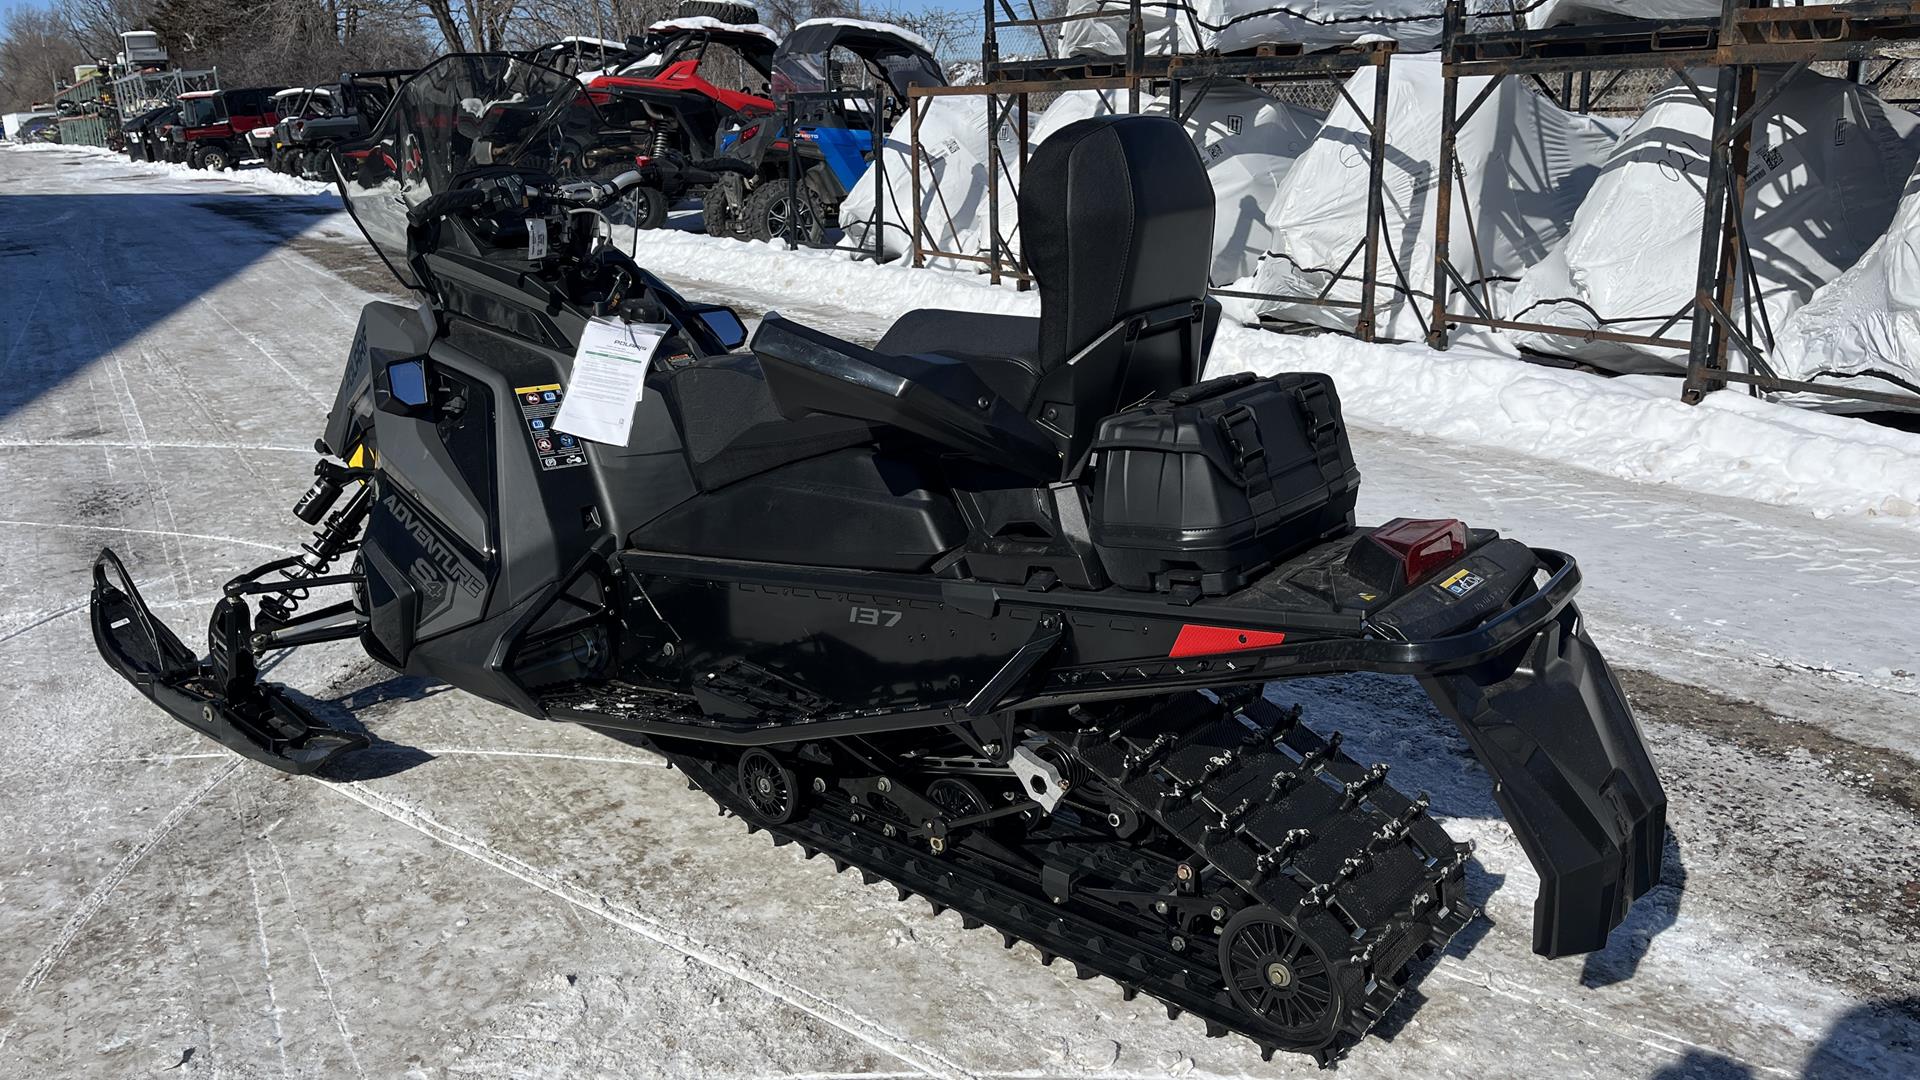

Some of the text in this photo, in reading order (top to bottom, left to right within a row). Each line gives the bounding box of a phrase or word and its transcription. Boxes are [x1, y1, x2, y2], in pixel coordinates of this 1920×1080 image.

[382, 494, 485, 599] ADVENTURE
[409, 557, 445, 598] S4
[849, 606, 902, 627] 137
